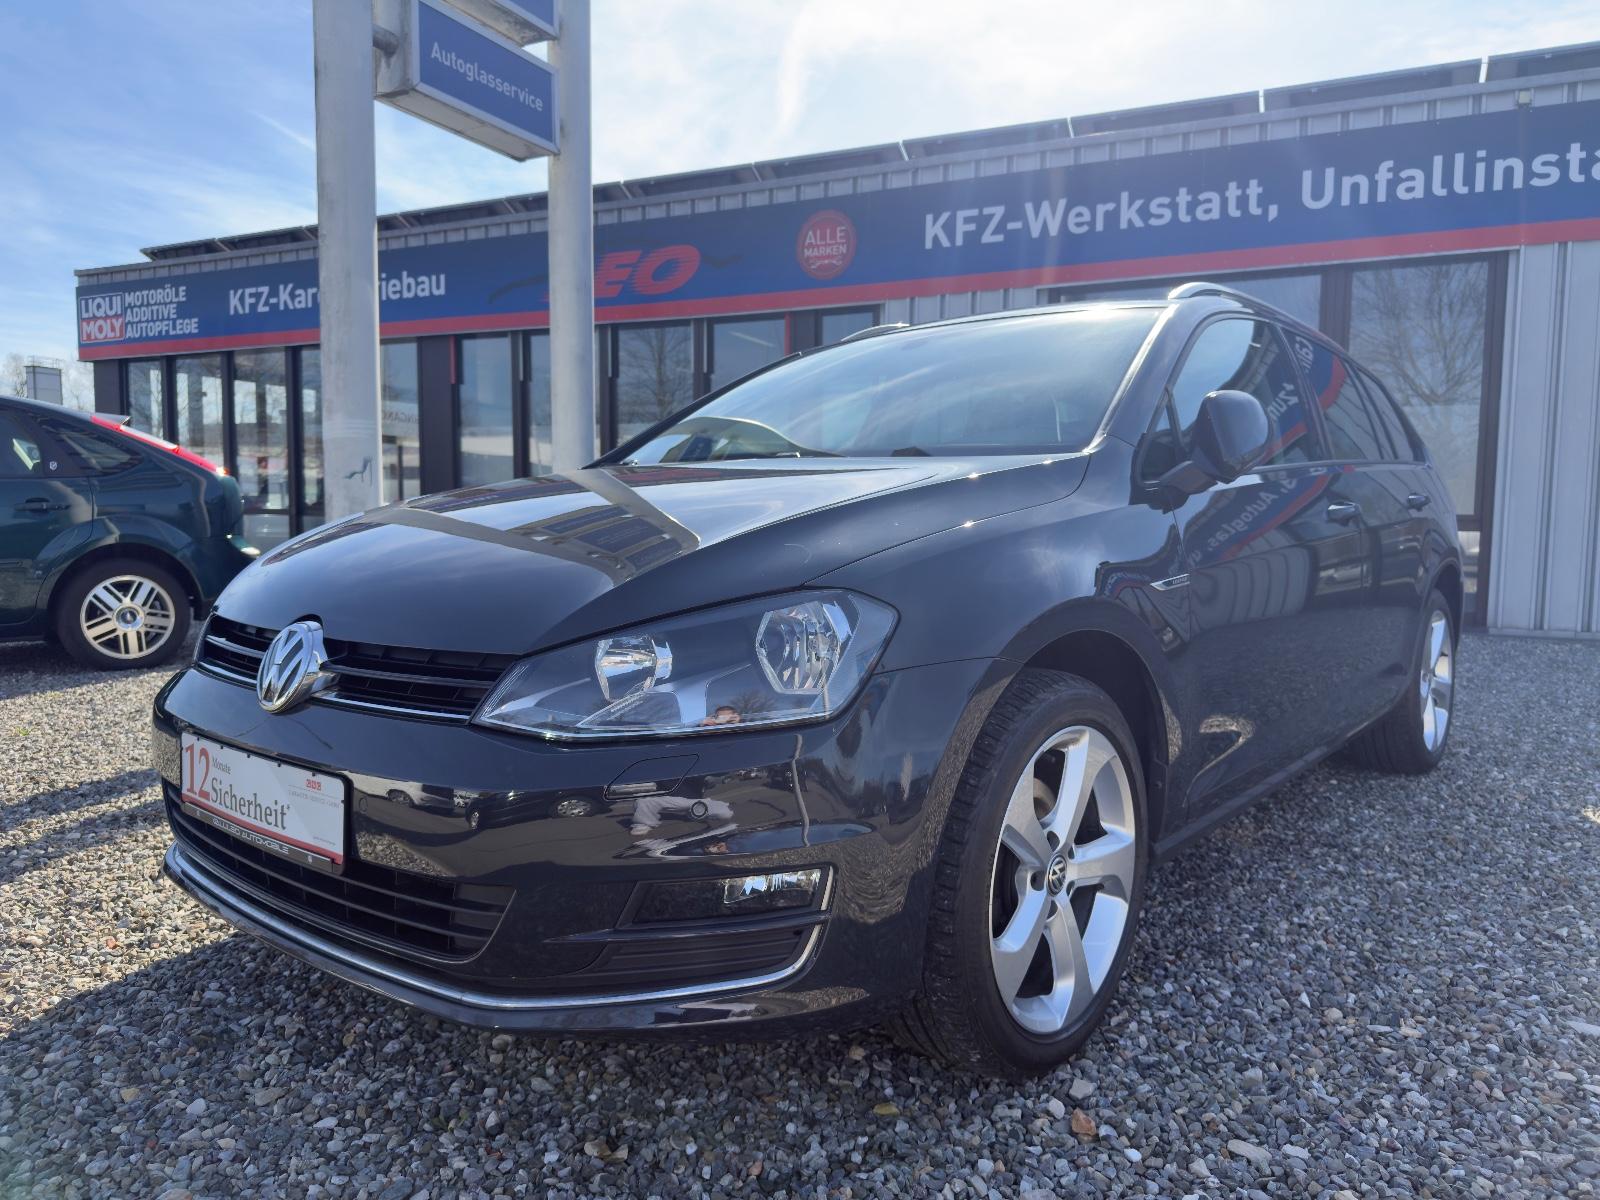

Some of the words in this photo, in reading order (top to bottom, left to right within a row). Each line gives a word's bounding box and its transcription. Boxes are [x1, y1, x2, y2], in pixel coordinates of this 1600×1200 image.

[431, 42, 543, 112] Autoglasservice
[925, 179, 1279, 249] KFZ-Werkstatt,
[804, 226, 846, 246] ALLE
[803, 244, 847, 259] MARKEN
[545, 245, 700, 303] EO
[125, 284, 187, 307] MOTORÖLE
[229, 270, 446, 316] KFZ-Kariebau
[81, 295, 122, 318] LIQUI
[125, 303, 178, 322] ADDITIVE
[82, 318, 122, 340] MOLY
[125, 318, 199, 338] AUTOPFLEGE
[185, 743, 210, 800] 12
